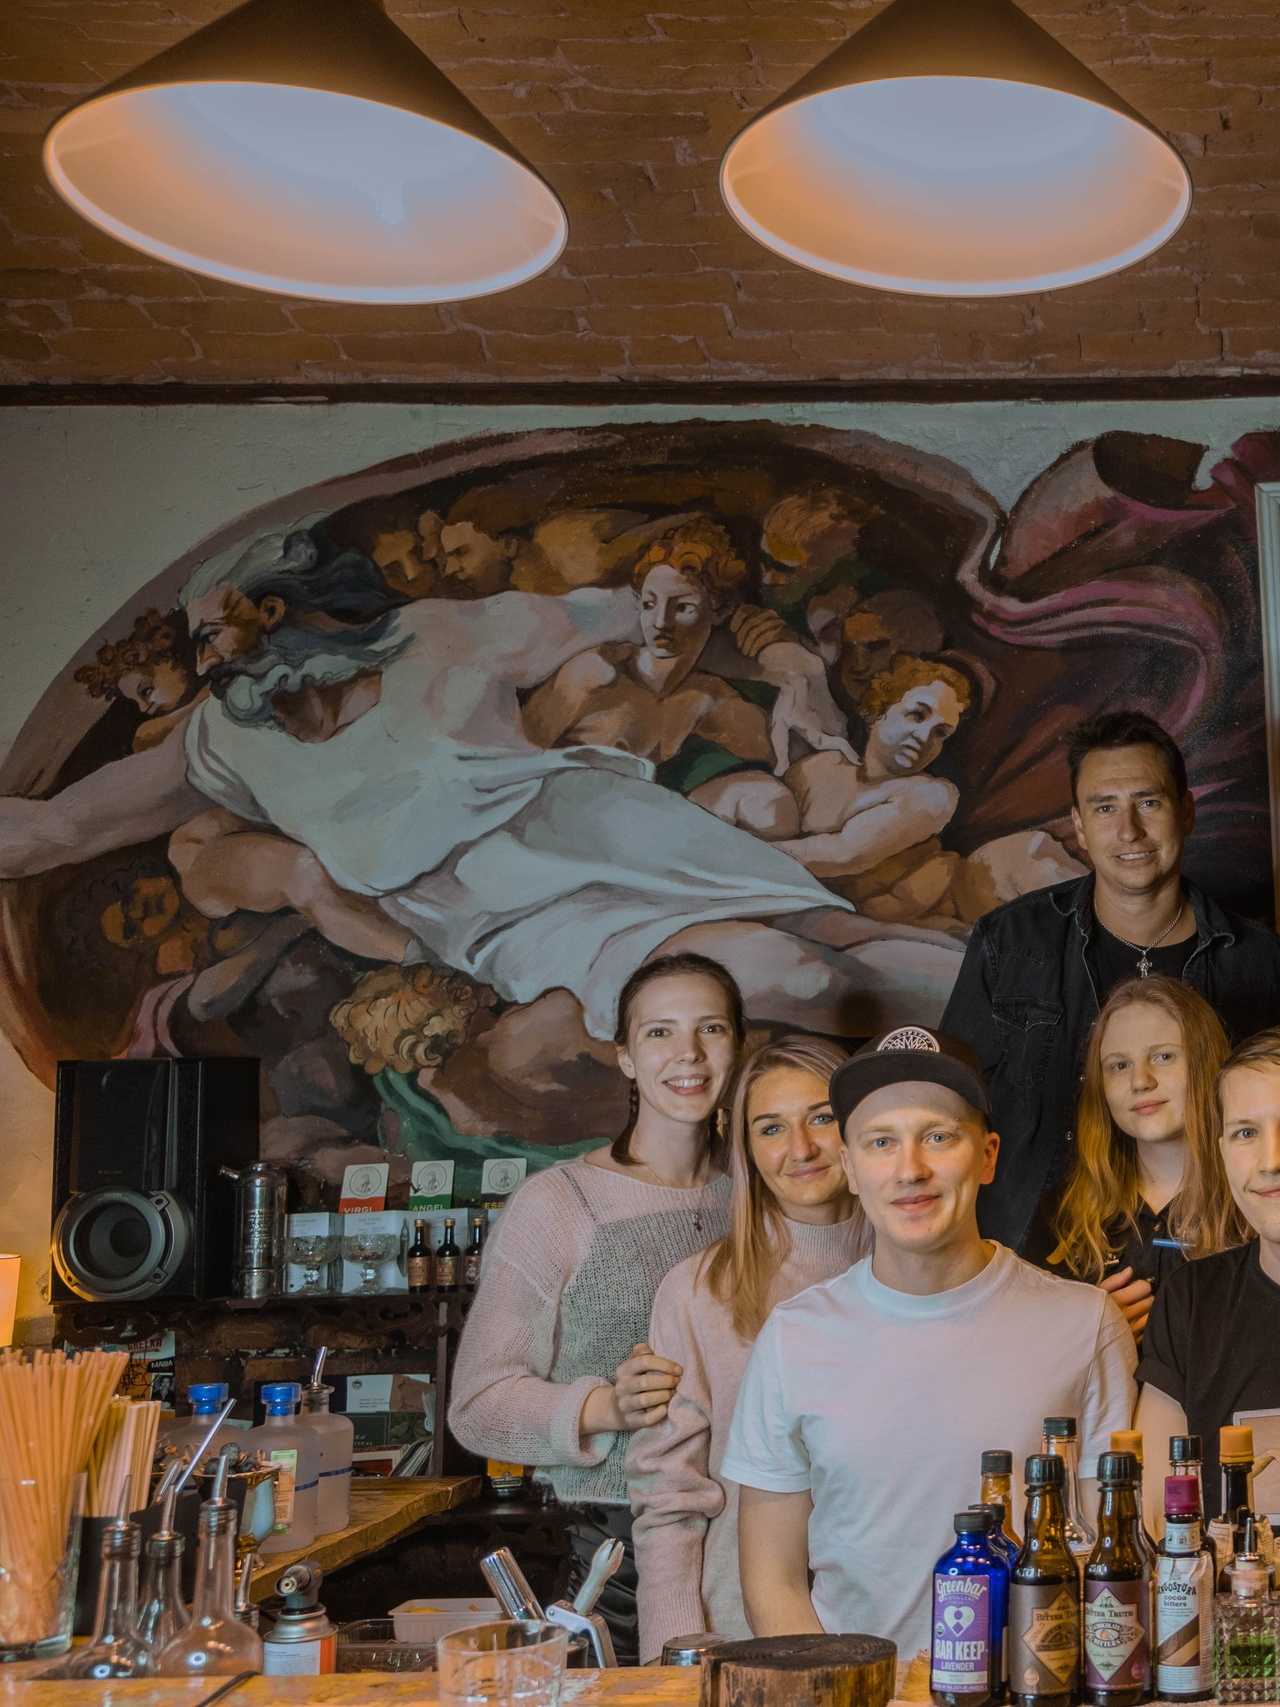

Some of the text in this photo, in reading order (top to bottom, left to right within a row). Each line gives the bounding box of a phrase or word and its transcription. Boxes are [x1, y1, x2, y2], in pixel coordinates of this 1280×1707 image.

[937, 1577, 988, 1602] Greenbar
[935, 1639, 985, 1661] BAR KEEP
[941, 1661, 975, 1671] LAVENDER
